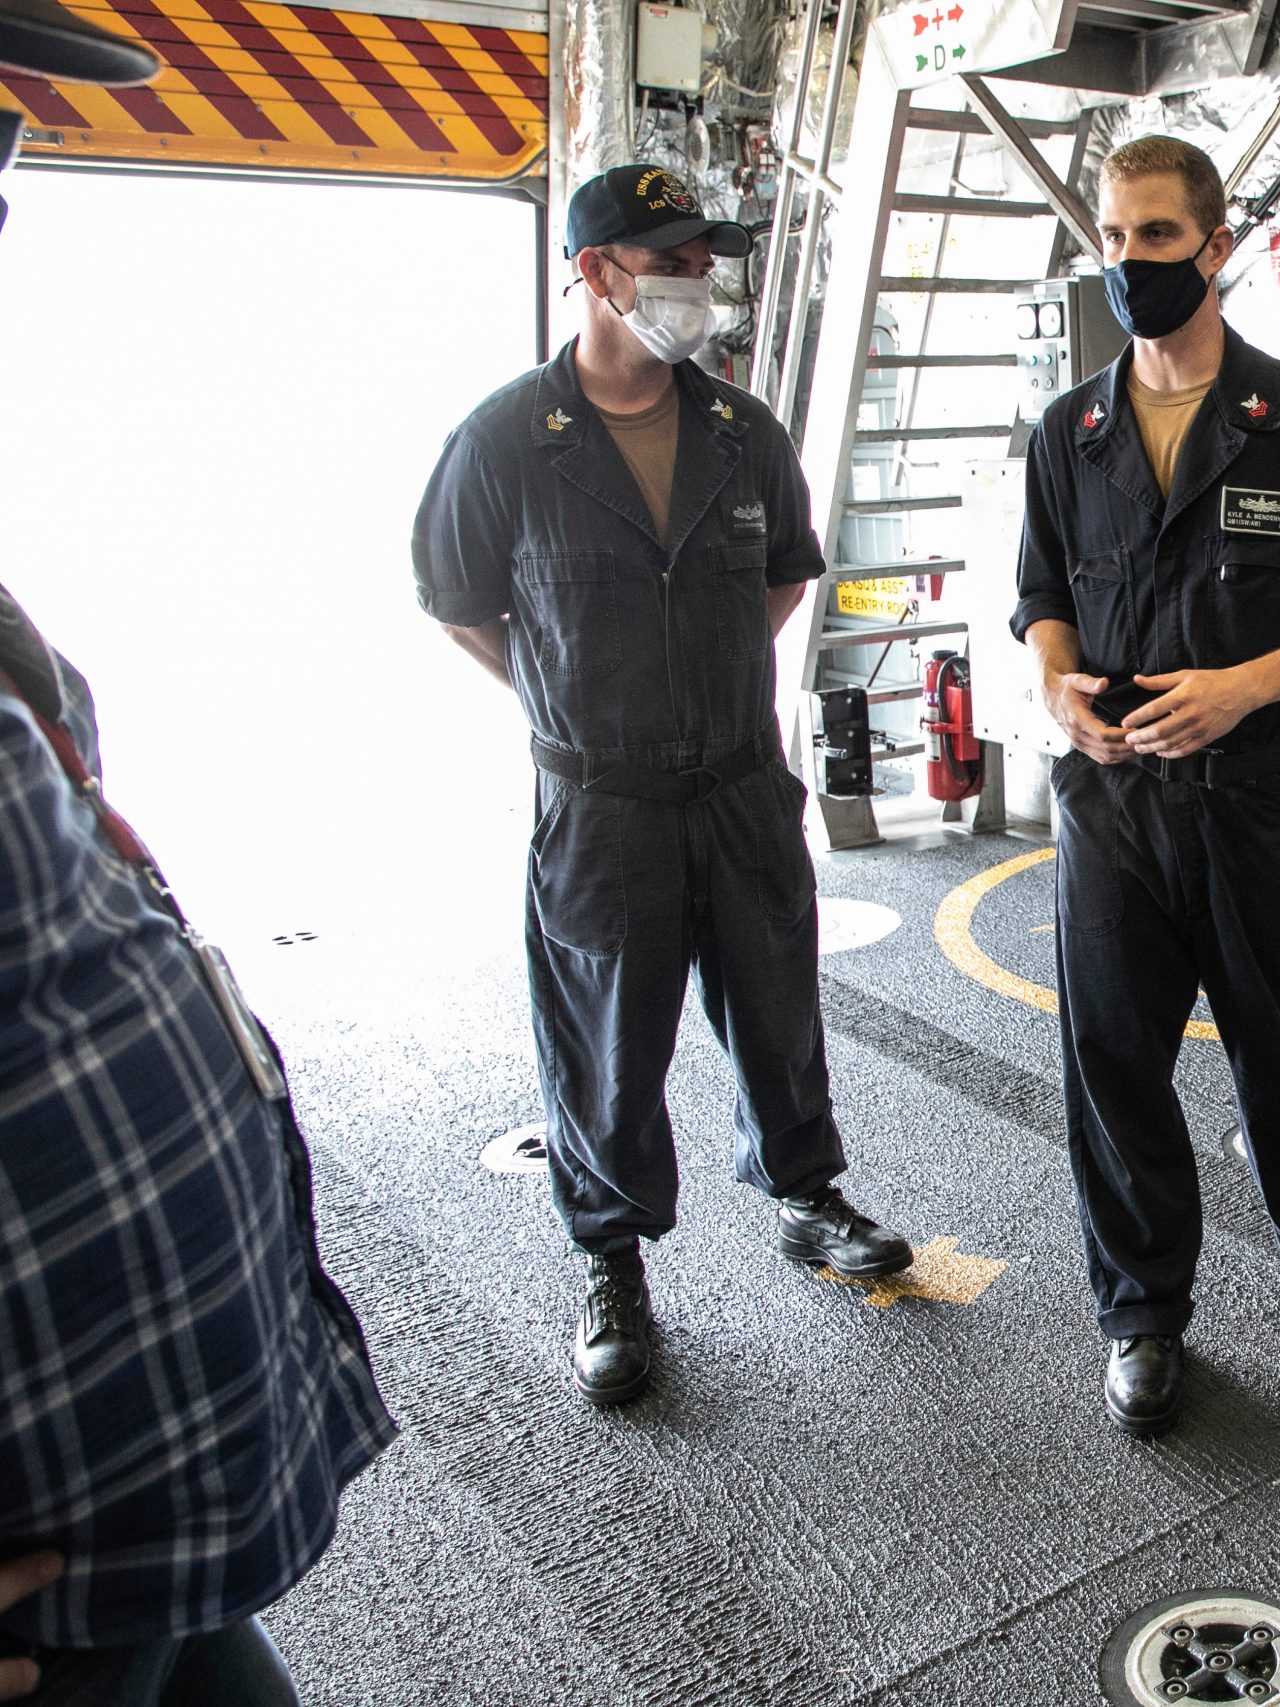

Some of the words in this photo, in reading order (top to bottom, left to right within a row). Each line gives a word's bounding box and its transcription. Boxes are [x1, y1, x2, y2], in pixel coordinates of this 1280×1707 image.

[934, 44, 946, 71] D
[636, 178, 649, 196] USS
[648, 199, 666, 210] LCS
[841, 595, 884, 613] RE-ENTRY
